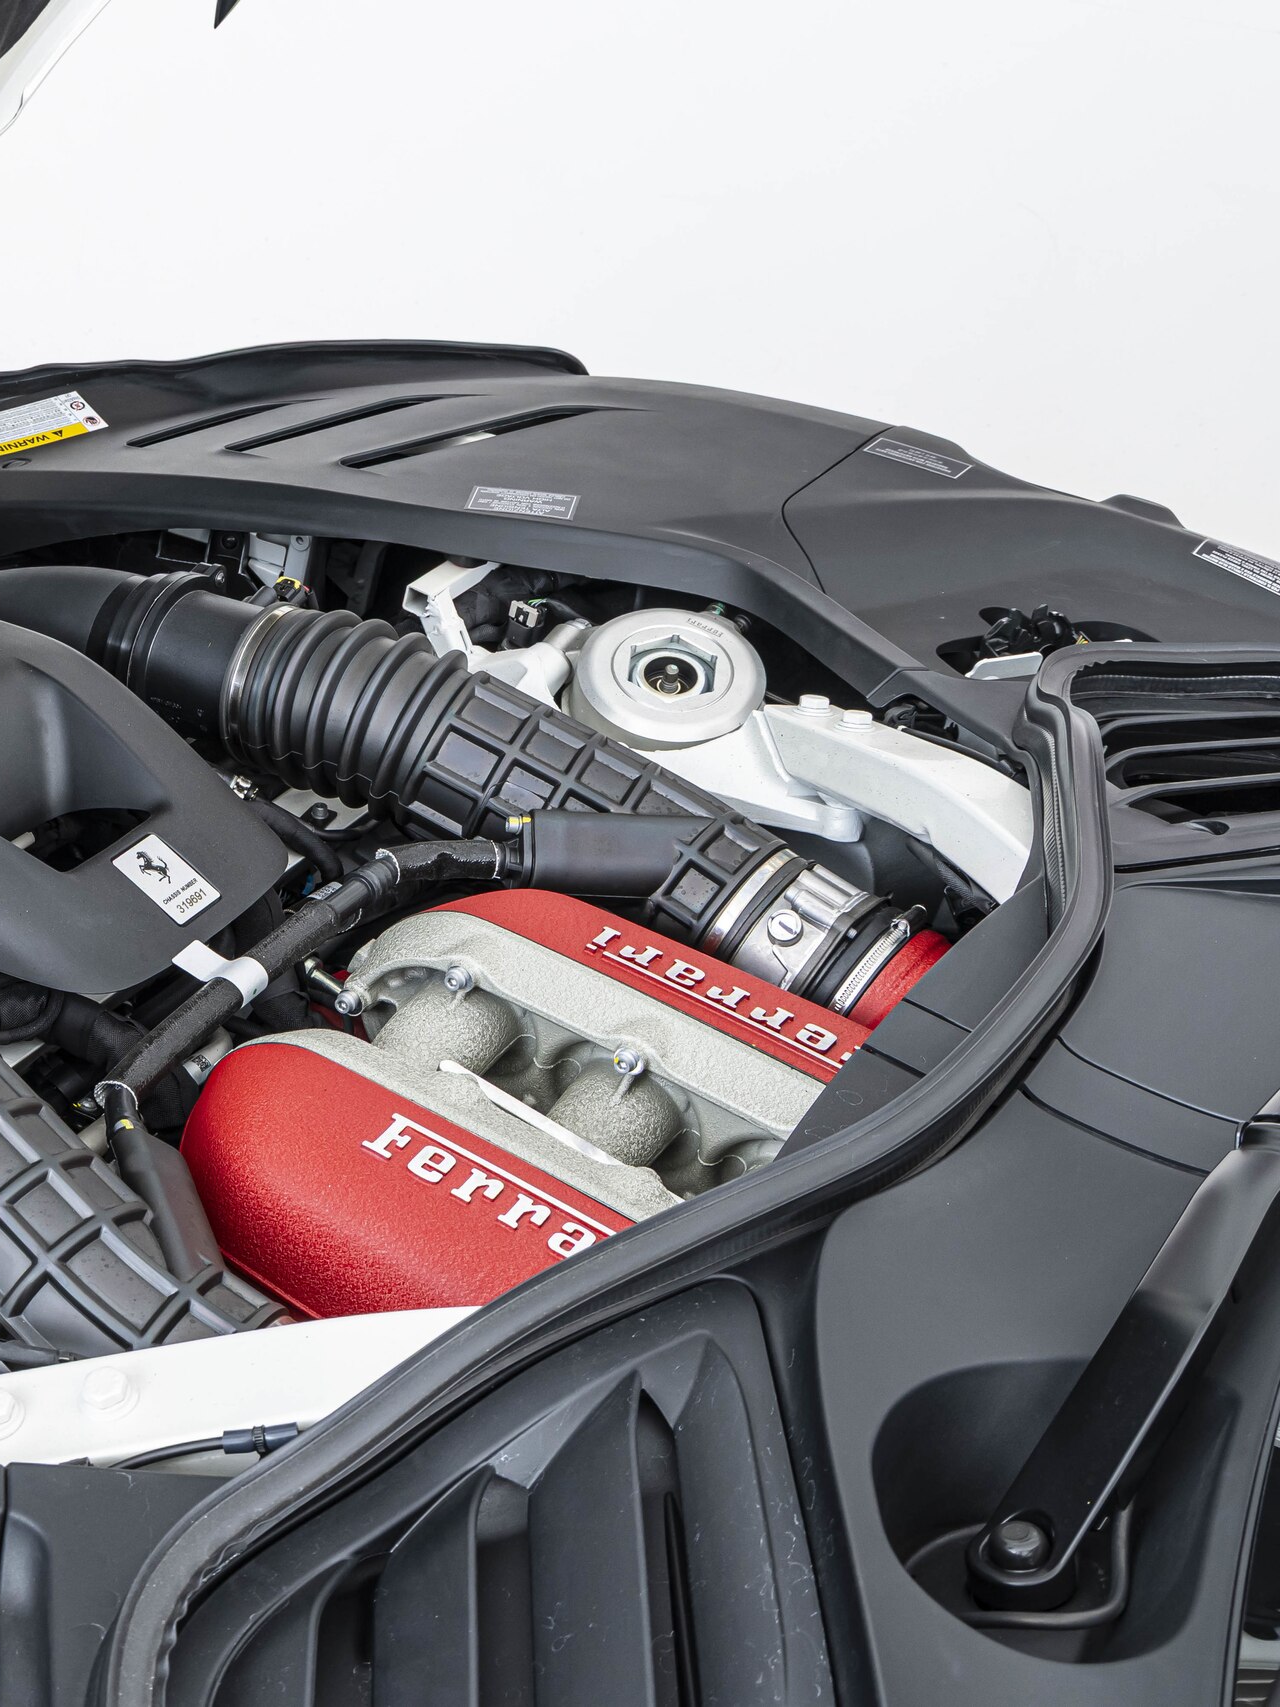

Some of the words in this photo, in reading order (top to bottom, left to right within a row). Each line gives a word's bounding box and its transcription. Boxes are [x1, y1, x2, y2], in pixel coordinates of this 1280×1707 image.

[163, 889, 181, 905] CHASSIS
[176, 888, 207, 914] 319691
[585, 926, 863, 1068] errari
